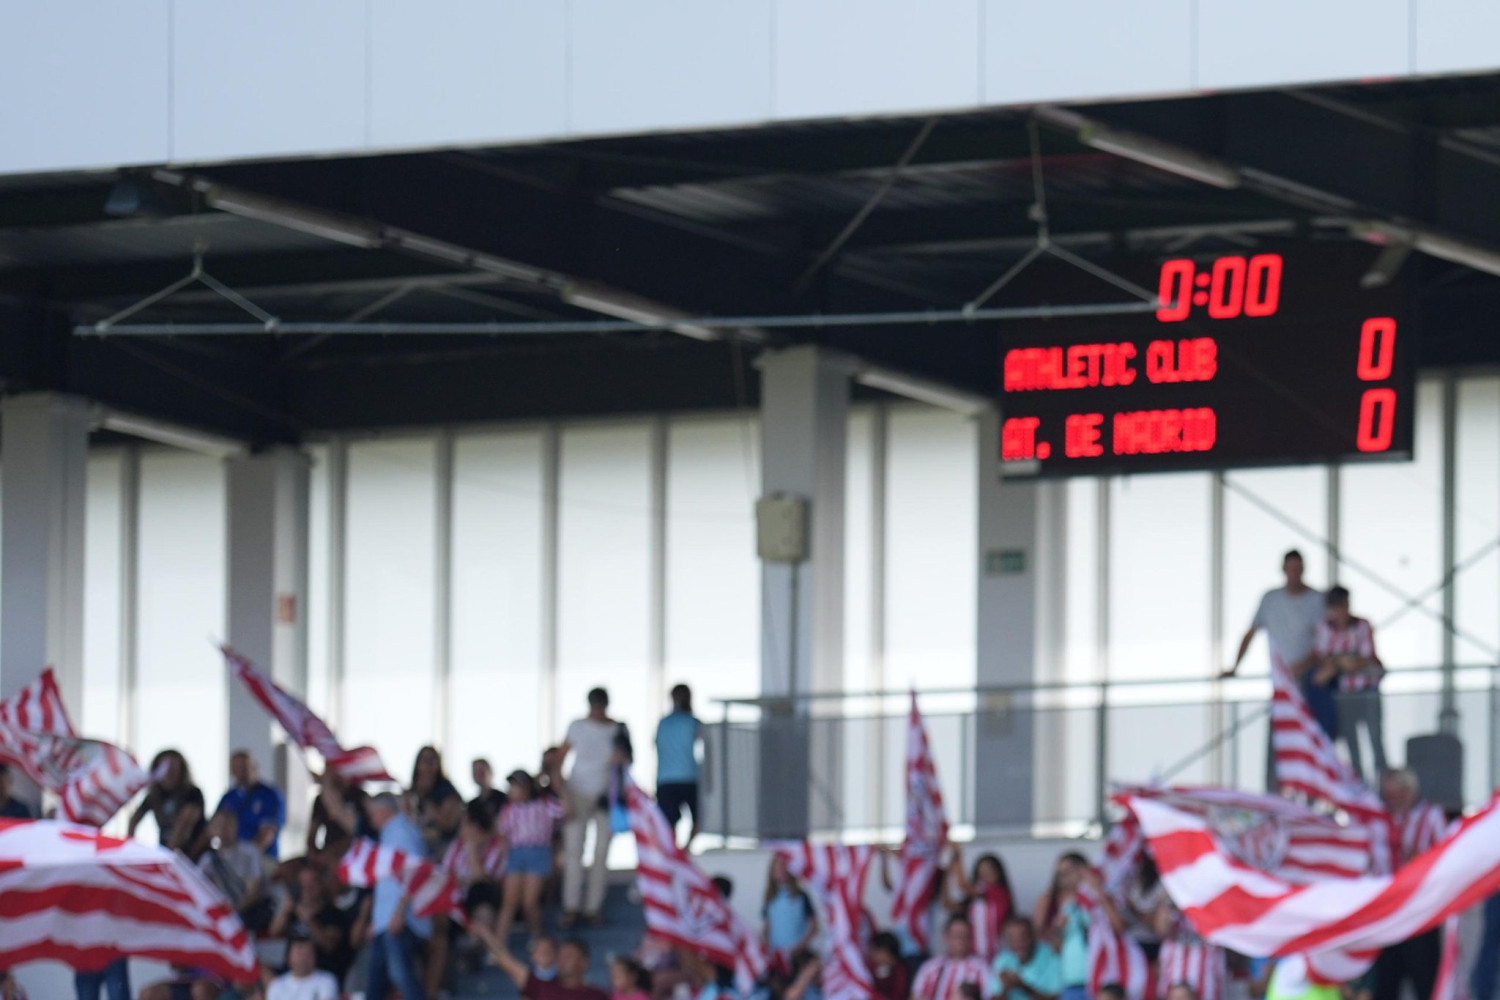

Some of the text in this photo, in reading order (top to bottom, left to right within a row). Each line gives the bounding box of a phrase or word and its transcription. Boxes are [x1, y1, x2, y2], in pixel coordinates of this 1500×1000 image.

[1156, 254, 1283, 322] 0:00
[1004, 337, 1218, 392] ATHLETIC CLUB
[1357, 317, 1397, 381] 0
[1065, 412, 1104, 458] DE
[1113, 406, 1217, 455] MADRID
[1357, 388, 1397, 452] 0
